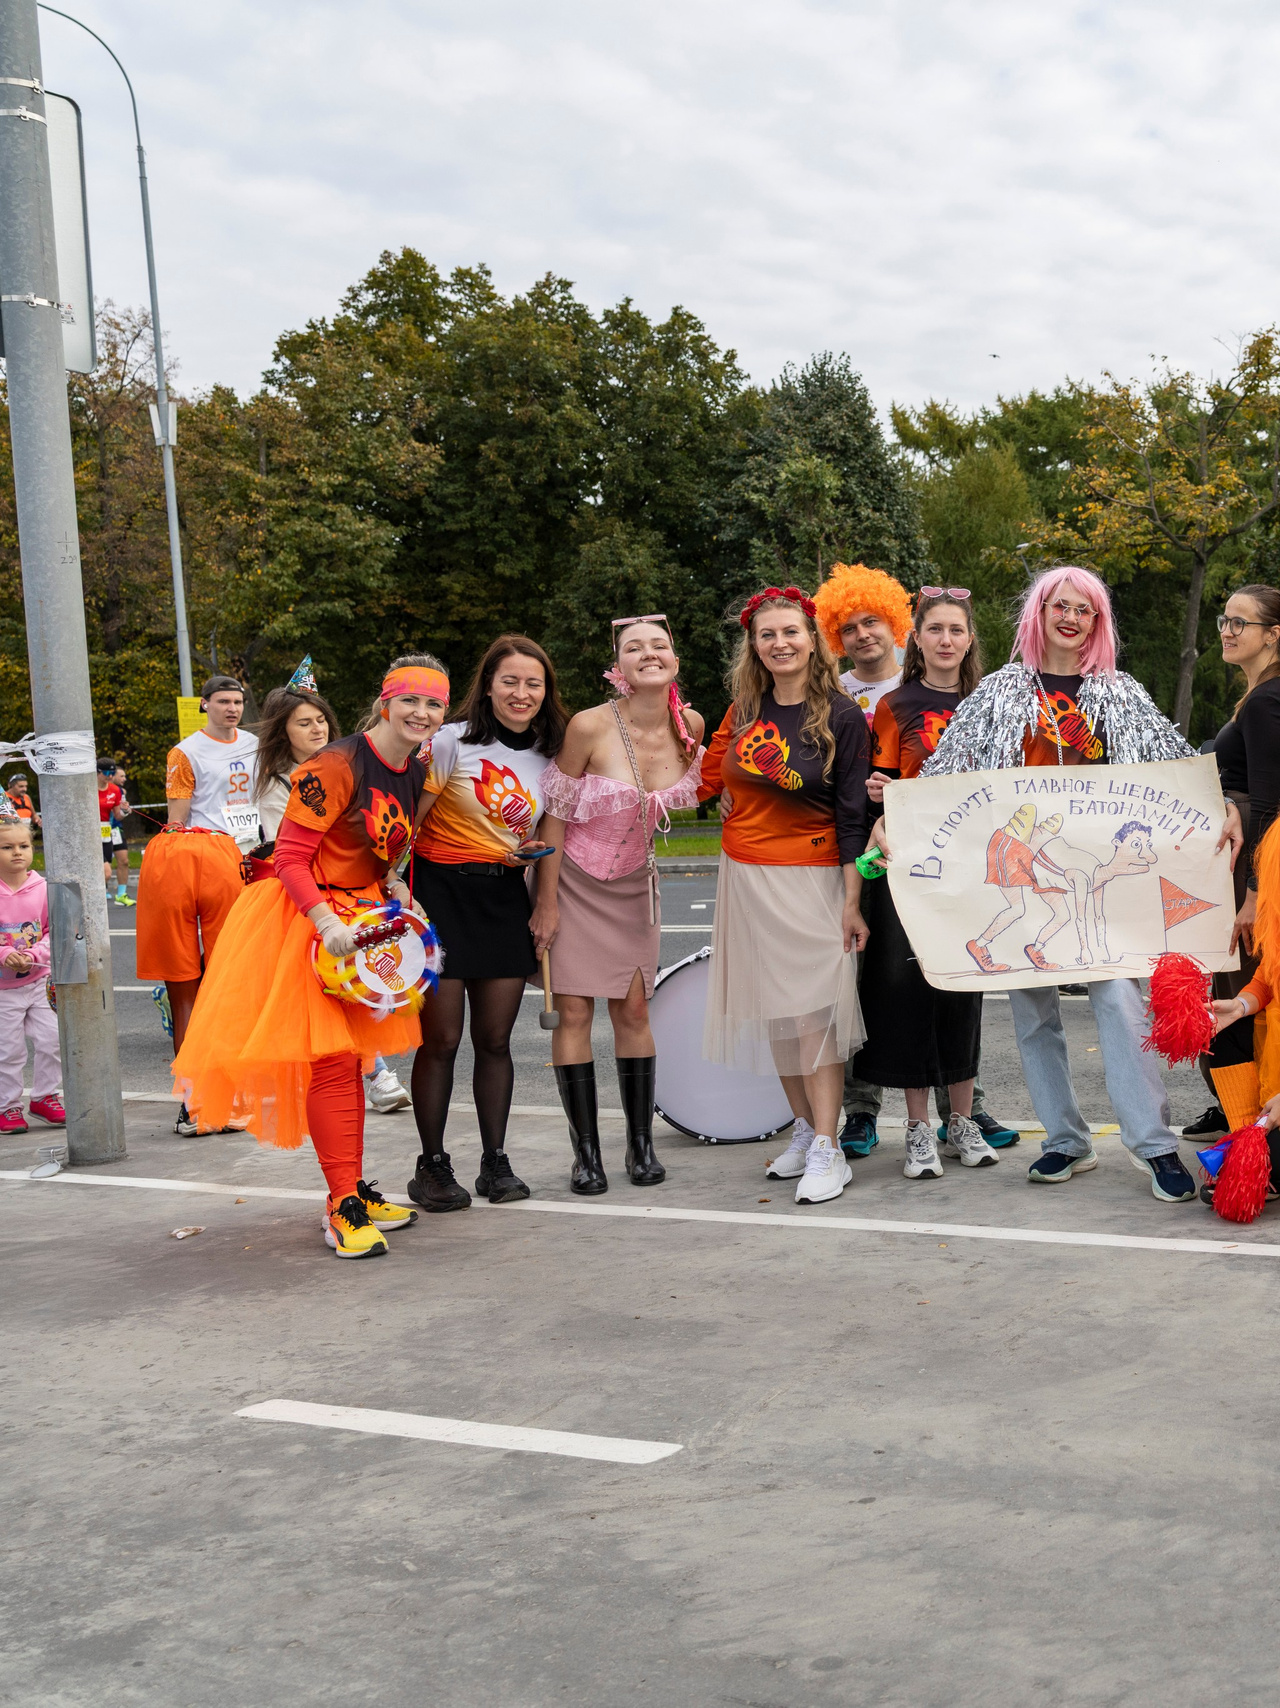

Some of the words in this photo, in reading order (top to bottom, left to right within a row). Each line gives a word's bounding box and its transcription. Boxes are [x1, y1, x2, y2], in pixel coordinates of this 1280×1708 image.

[227, 813, 258, 828] 17097
[909, 855, 943, 880] В
[932, 785, 997, 850] СПОРТЕ
[1014, 778, 1097, 796] ГЛАВНОЕ
[1108, 780, 1211, 832] ШЕВЕЛИТЬ
[1162, 897, 1199, 911] СТАРТ
